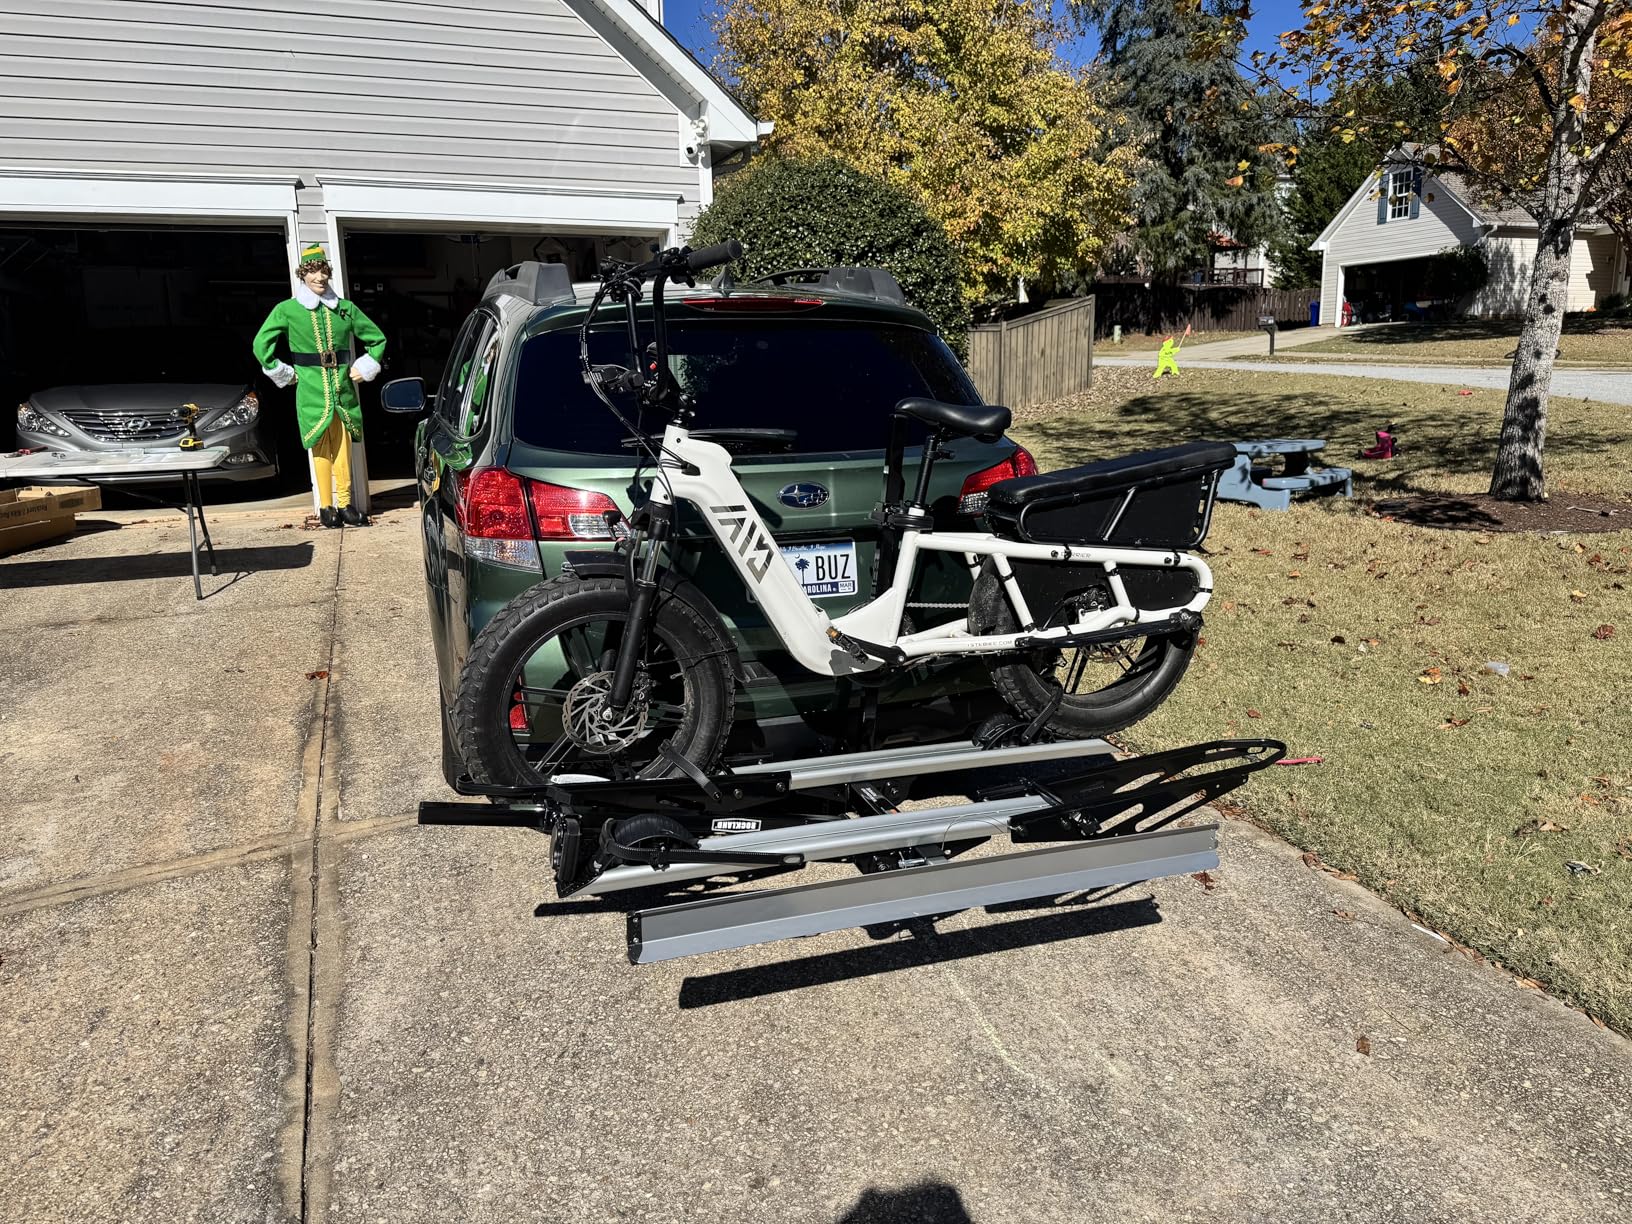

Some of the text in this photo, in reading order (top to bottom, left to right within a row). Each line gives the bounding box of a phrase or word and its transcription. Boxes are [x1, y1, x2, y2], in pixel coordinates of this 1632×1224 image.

[815, 553, 851, 581] BUZ
[803, 583, 832, 594] AROLINA
[716, 821, 757, 830] ROCKLAND
